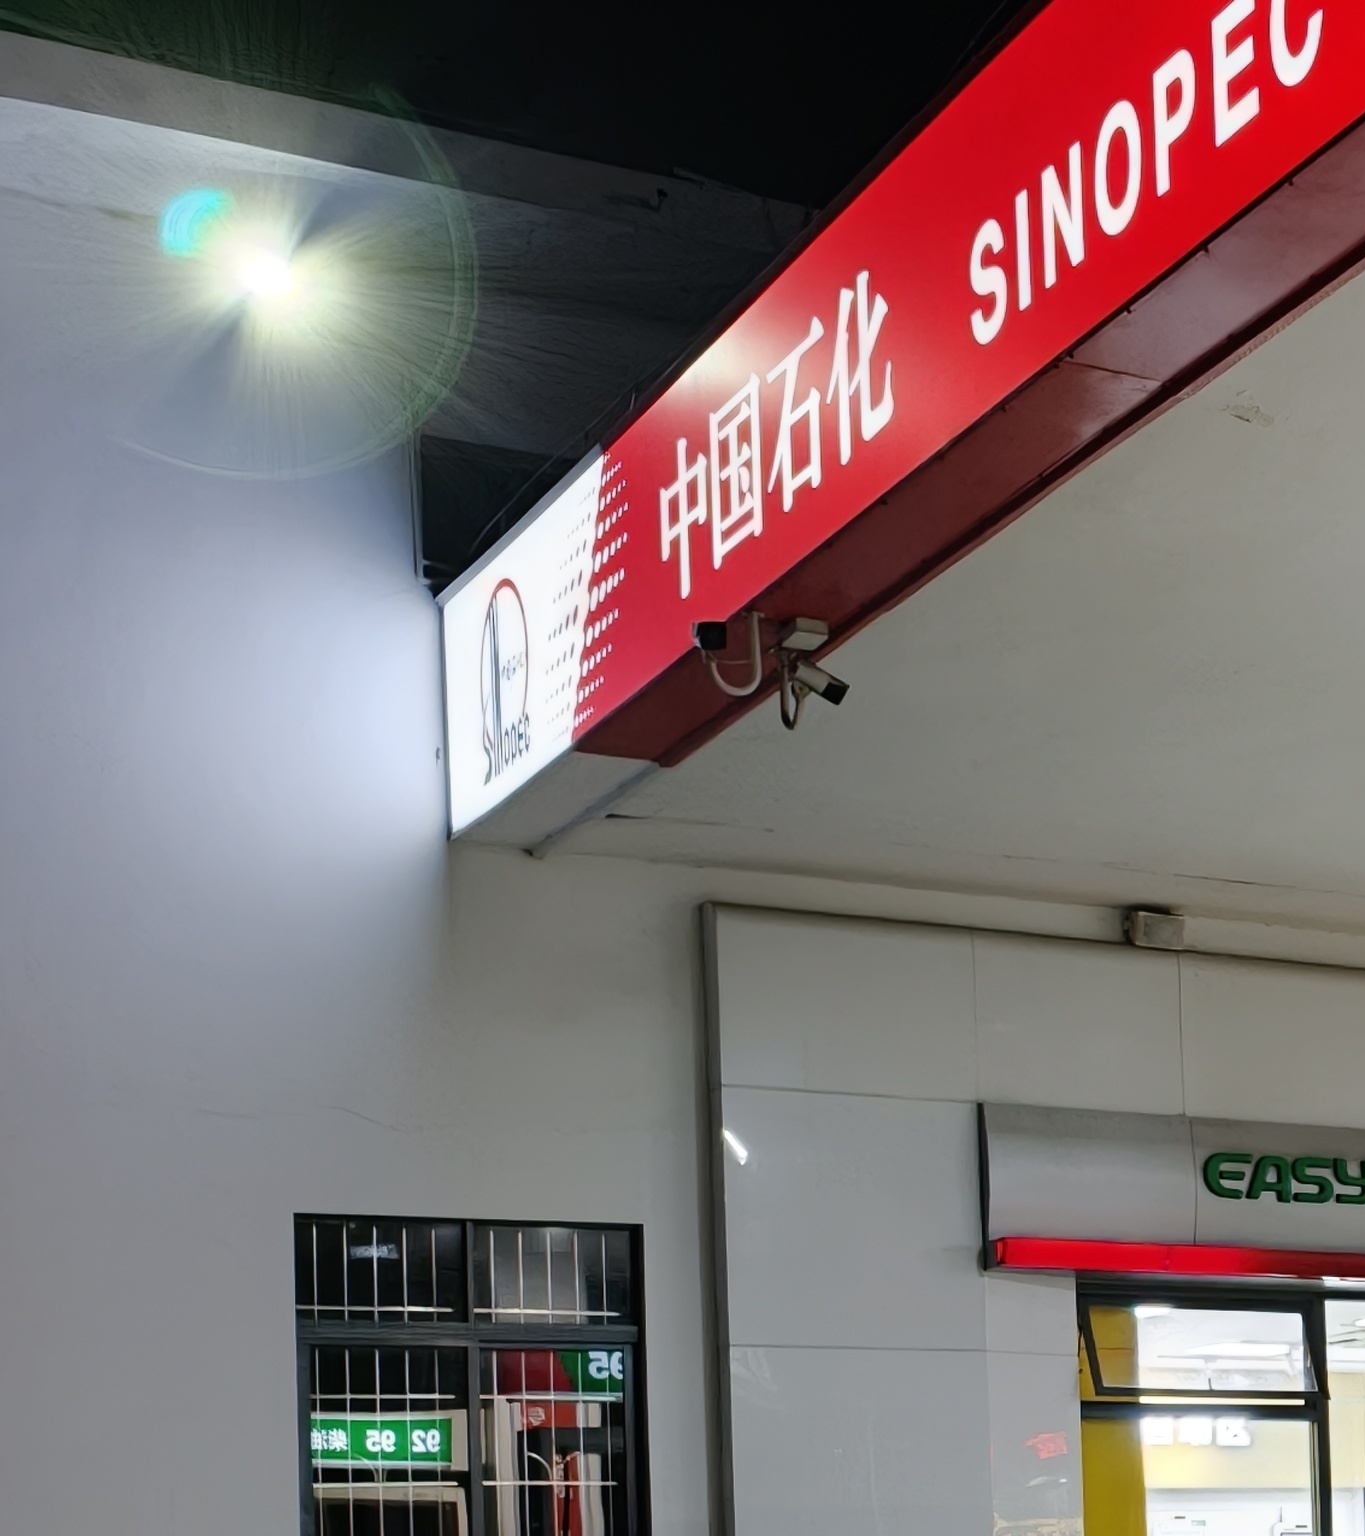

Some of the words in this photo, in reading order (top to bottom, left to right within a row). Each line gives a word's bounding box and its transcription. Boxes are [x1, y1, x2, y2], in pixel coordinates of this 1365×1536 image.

[969, 0, 1323, 346] SINOPEC
[659, 270, 895, 600] 中国石化
